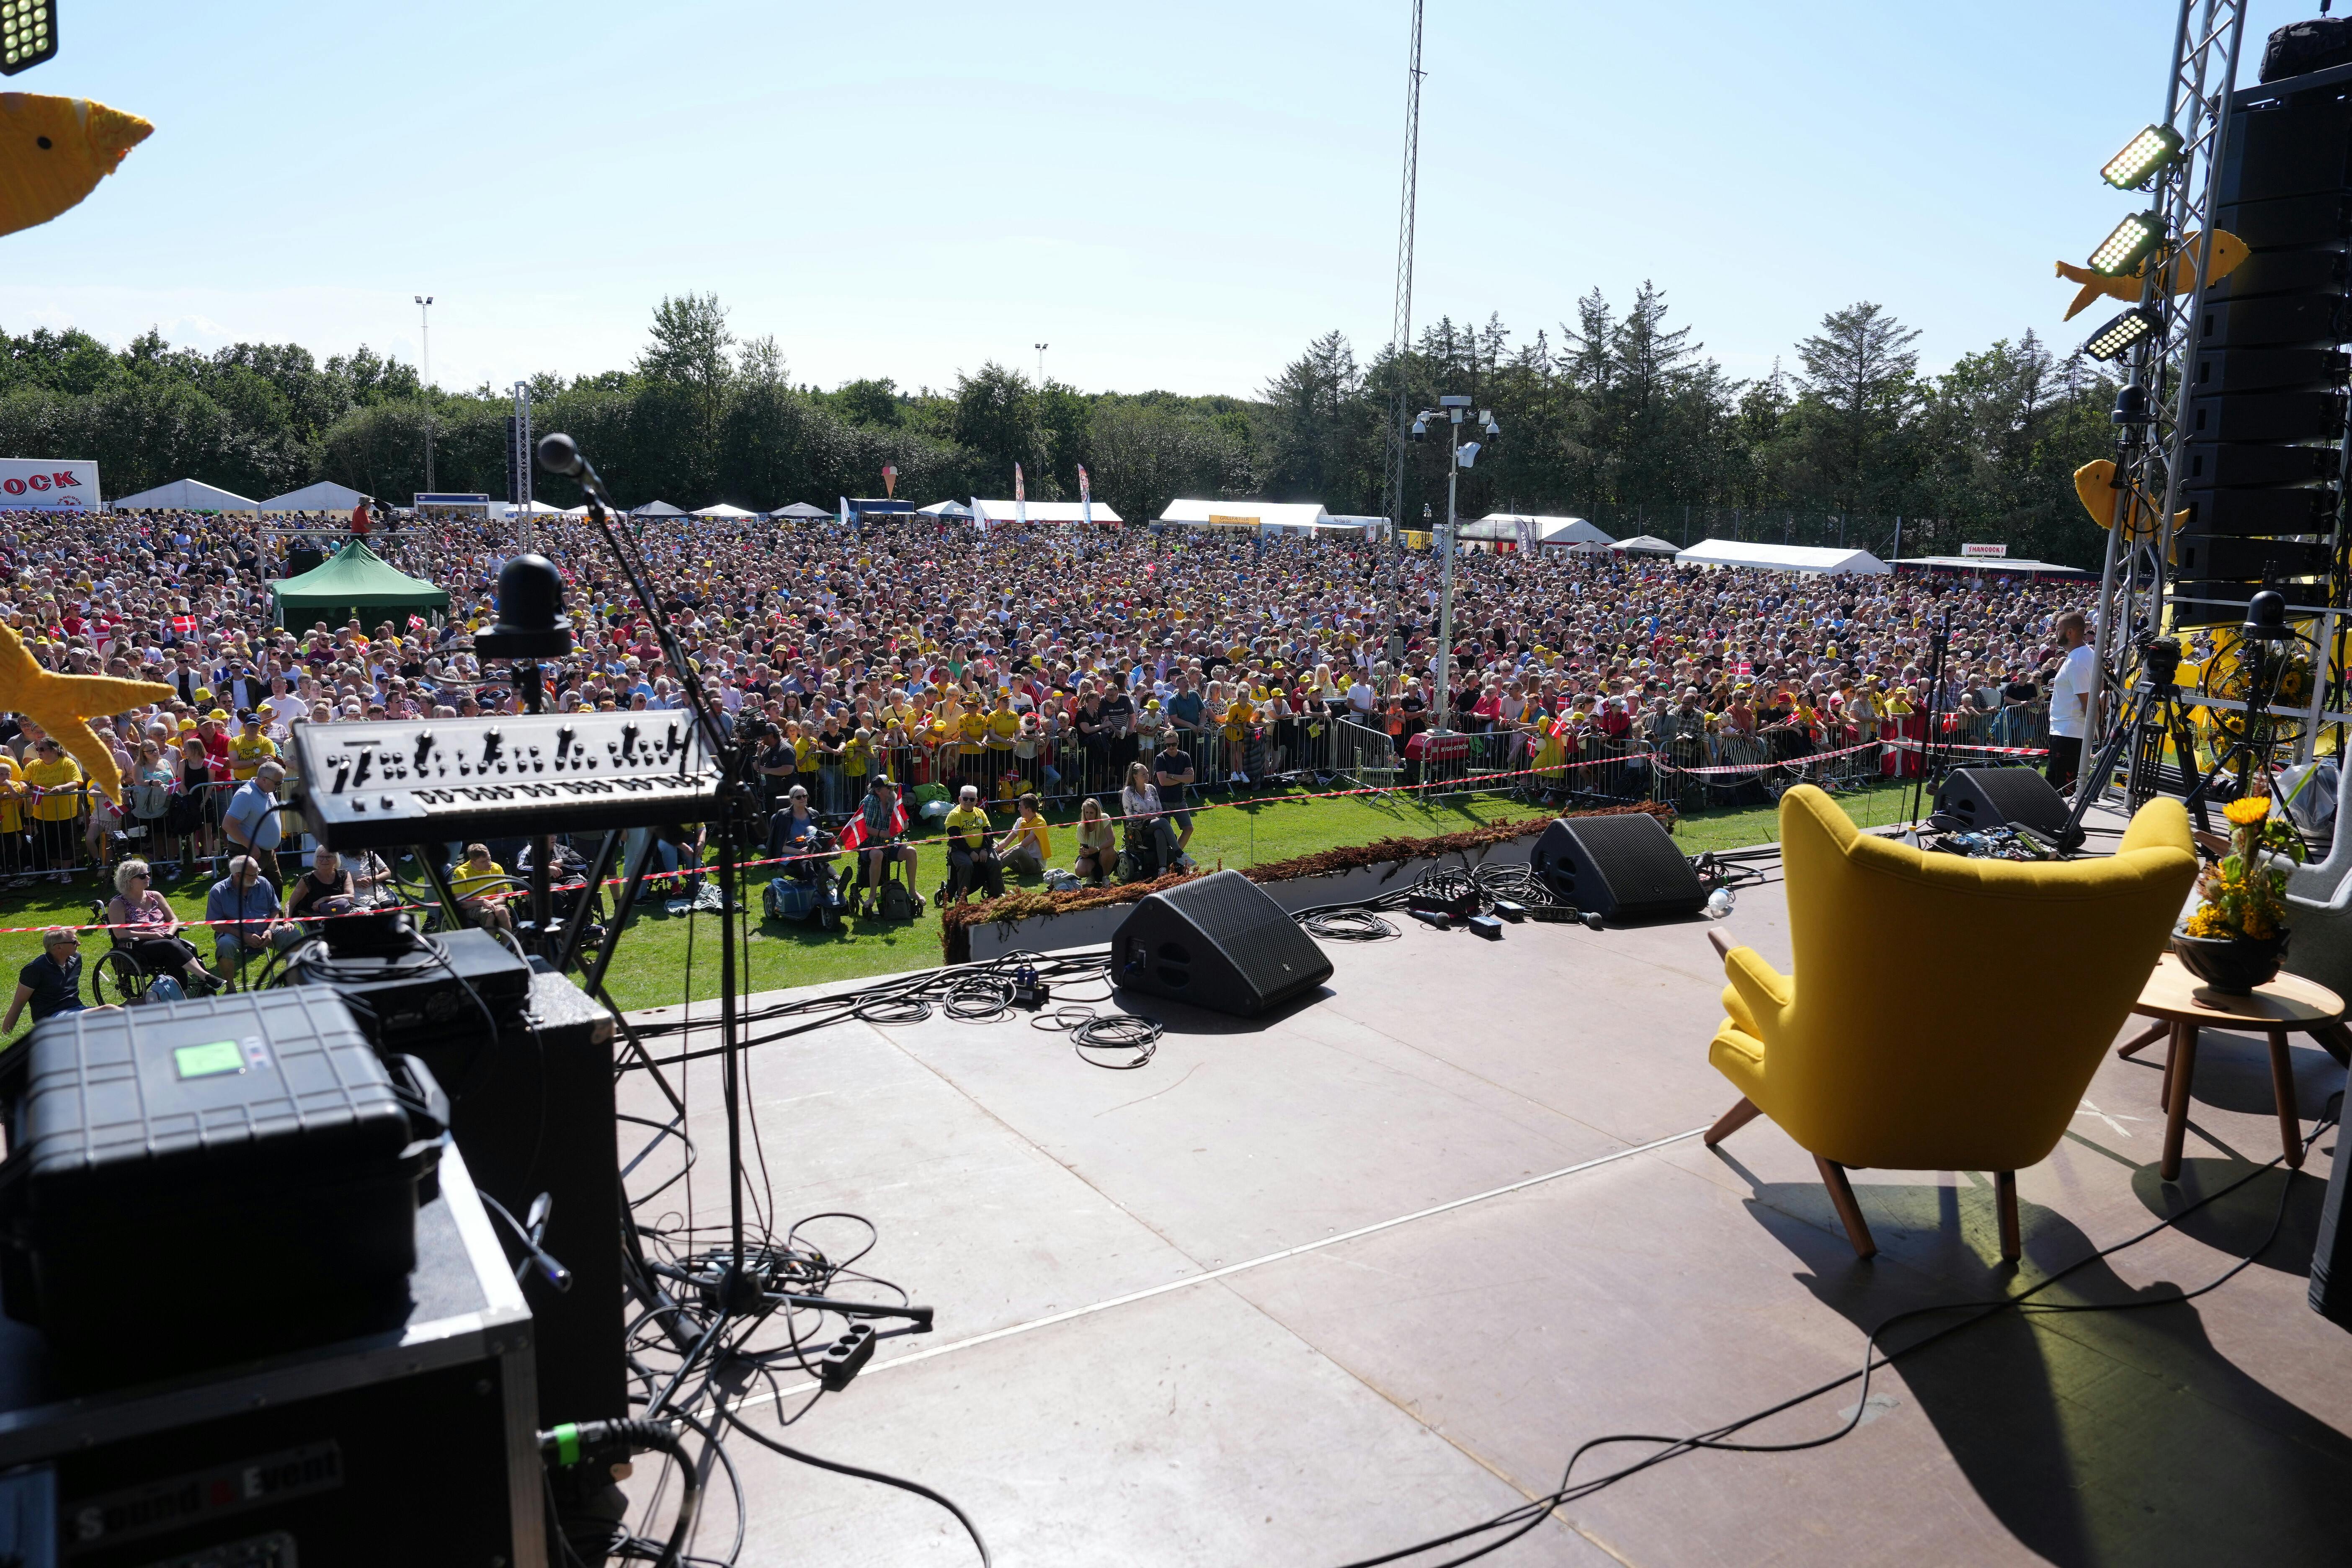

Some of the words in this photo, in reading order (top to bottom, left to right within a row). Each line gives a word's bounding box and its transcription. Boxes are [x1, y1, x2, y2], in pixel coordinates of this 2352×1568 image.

[0, 471, 83, 495] OCK
[1441, 743, 1469, 752] BYGG-STRÖM
[76, 1480, 202, 1542] Sound
[242, 1448, 337, 1500] Event
